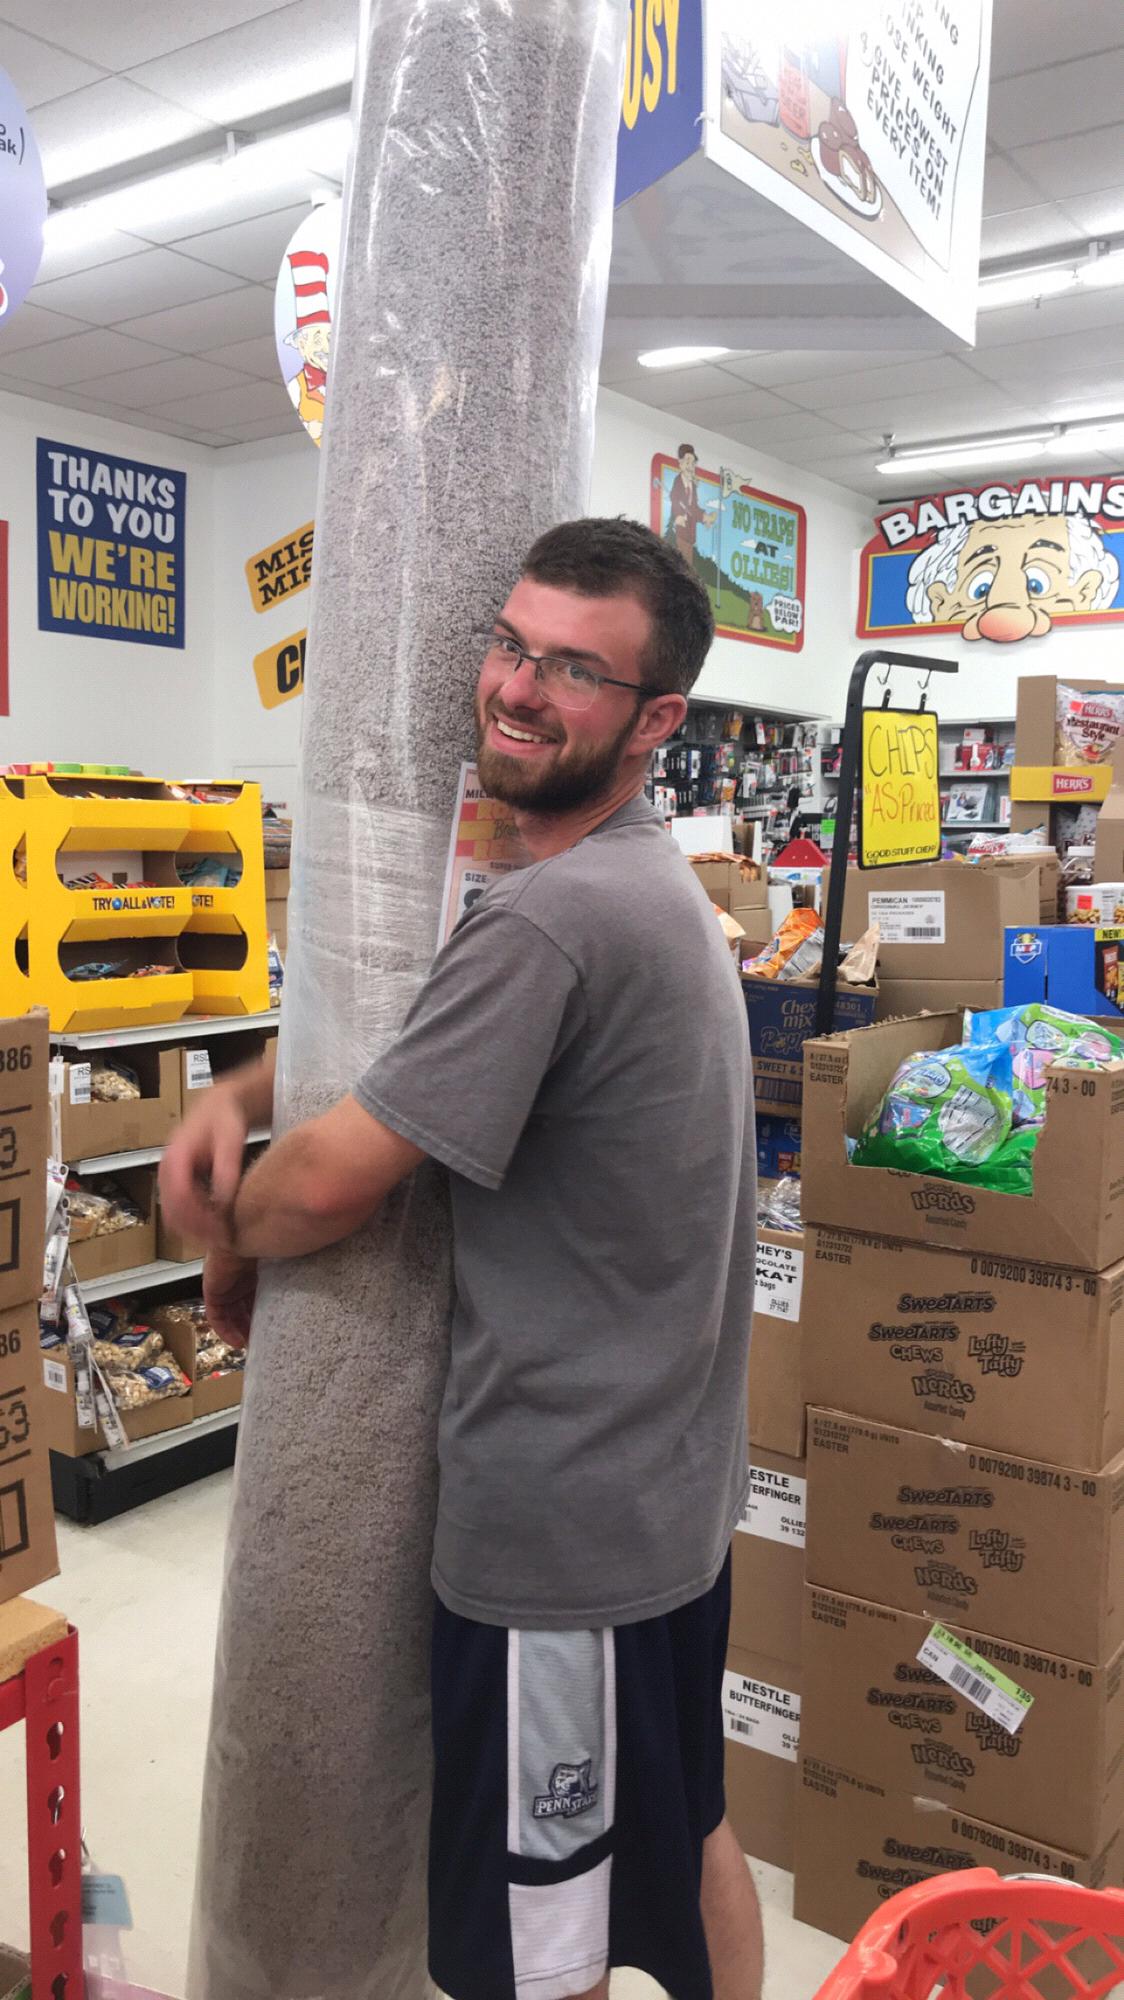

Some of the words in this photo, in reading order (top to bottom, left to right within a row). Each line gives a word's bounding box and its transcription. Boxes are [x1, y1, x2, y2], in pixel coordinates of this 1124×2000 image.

[875, 45, 901, 100] GIVE
[905, 97, 949, 177] LOWEST
[912, 60, 957, 144] WEIGHT
[872, 66, 921, 159] PRICES
[926, 158, 944, 196] ON
[867, 88, 907, 160] EVERY
[909, 158, 941, 221] ITEM!
[47, 451, 176, 509] THANKS
[47, 489, 94, 528] TO
[106, 502, 176, 544] YOU
[732, 500, 750, 533] NO
[754, 507, 795, 547] TRAPS
[880, 482, 1124, 547] BARGAINS
[48, 530, 176, 592] WE'RE
[754, 541, 779, 559] AT
[48, 577, 176, 635] WORKING!
[774, 615, 799, 627] PAR!
[1066, 716, 1120, 736] Restaurant
[1082, 728, 1105, 742] Style
[868, 725, 935, 780] CHIPS
[1055, 778, 1089, 790] HERR'S
[892, 846, 914, 857] STUFF
[92, 897, 112, 911] TRY
[122, 896, 141, 910] ALL
[781, 999, 818, 1017] Chex
[783, 1015, 812, 1029] mix
[757, 1061, 787, 1073] SWEET
[809, 1073, 843, 1085] EASTER
[1062, 1078, 1070, 1094] 3
[1081, 1080, 1096, 1097] 00
[756, 1244, 792, 1260] HEY'S
[815, 1250, 851, 1265] EASTER
[756, 1268, 797, 1284] KAT
[760, 1280, 776, 1291] bags
[971, 1258, 978, 1274] 0
[981, 1260, 1026, 1283] 0079200
[1028, 1269, 1062, 1290] 39874
[1065, 1275, 1072, 1291] 3
[1083, 1279, 1097, 1296] 00
[968, 1334, 1008, 1357] Laffy
[978, 1355, 1023, 1377] Taffy
[813, 1437, 848, 1454] EASTER
[750, 1469, 790, 1488] ESTLE
[969, 1454, 976, 1469] 0
[978, 1456, 1024, 1480] 0079200
[1027, 1467, 1060, 1489] 39874
[1063, 1476, 1071, 1491] 3
[1082, 1480, 1096, 1497] 00
[750, 1483, 801, 1505] ERFINGER
[968, 1528, 1008, 1551] Laffy
[979, 1550, 1025, 1573] Taffy
[812, 1610, 846, 1629] EASTER
[975, 1639, 1020, 1665] 0079200
[1023, 1652, 1056, 1676] 39874
[1060, 1664, 1067, 1679] 3
[1078, 1668, 1092, 1687] 00
[742, 1680, 791, 1705] NESTLE
[976, 1731, 1022, 1757] Taffy
[538, 1798, 571, 1813] PENN
[952, 1818, 958, 1833] 0
[961, 1823, 1006, 1852] 0079200
[1008, 1840, 1041, 1866] 39874
[1043, 1855, 1050, 1870] 3
[1061, 1863, 1075, 1879] 00
